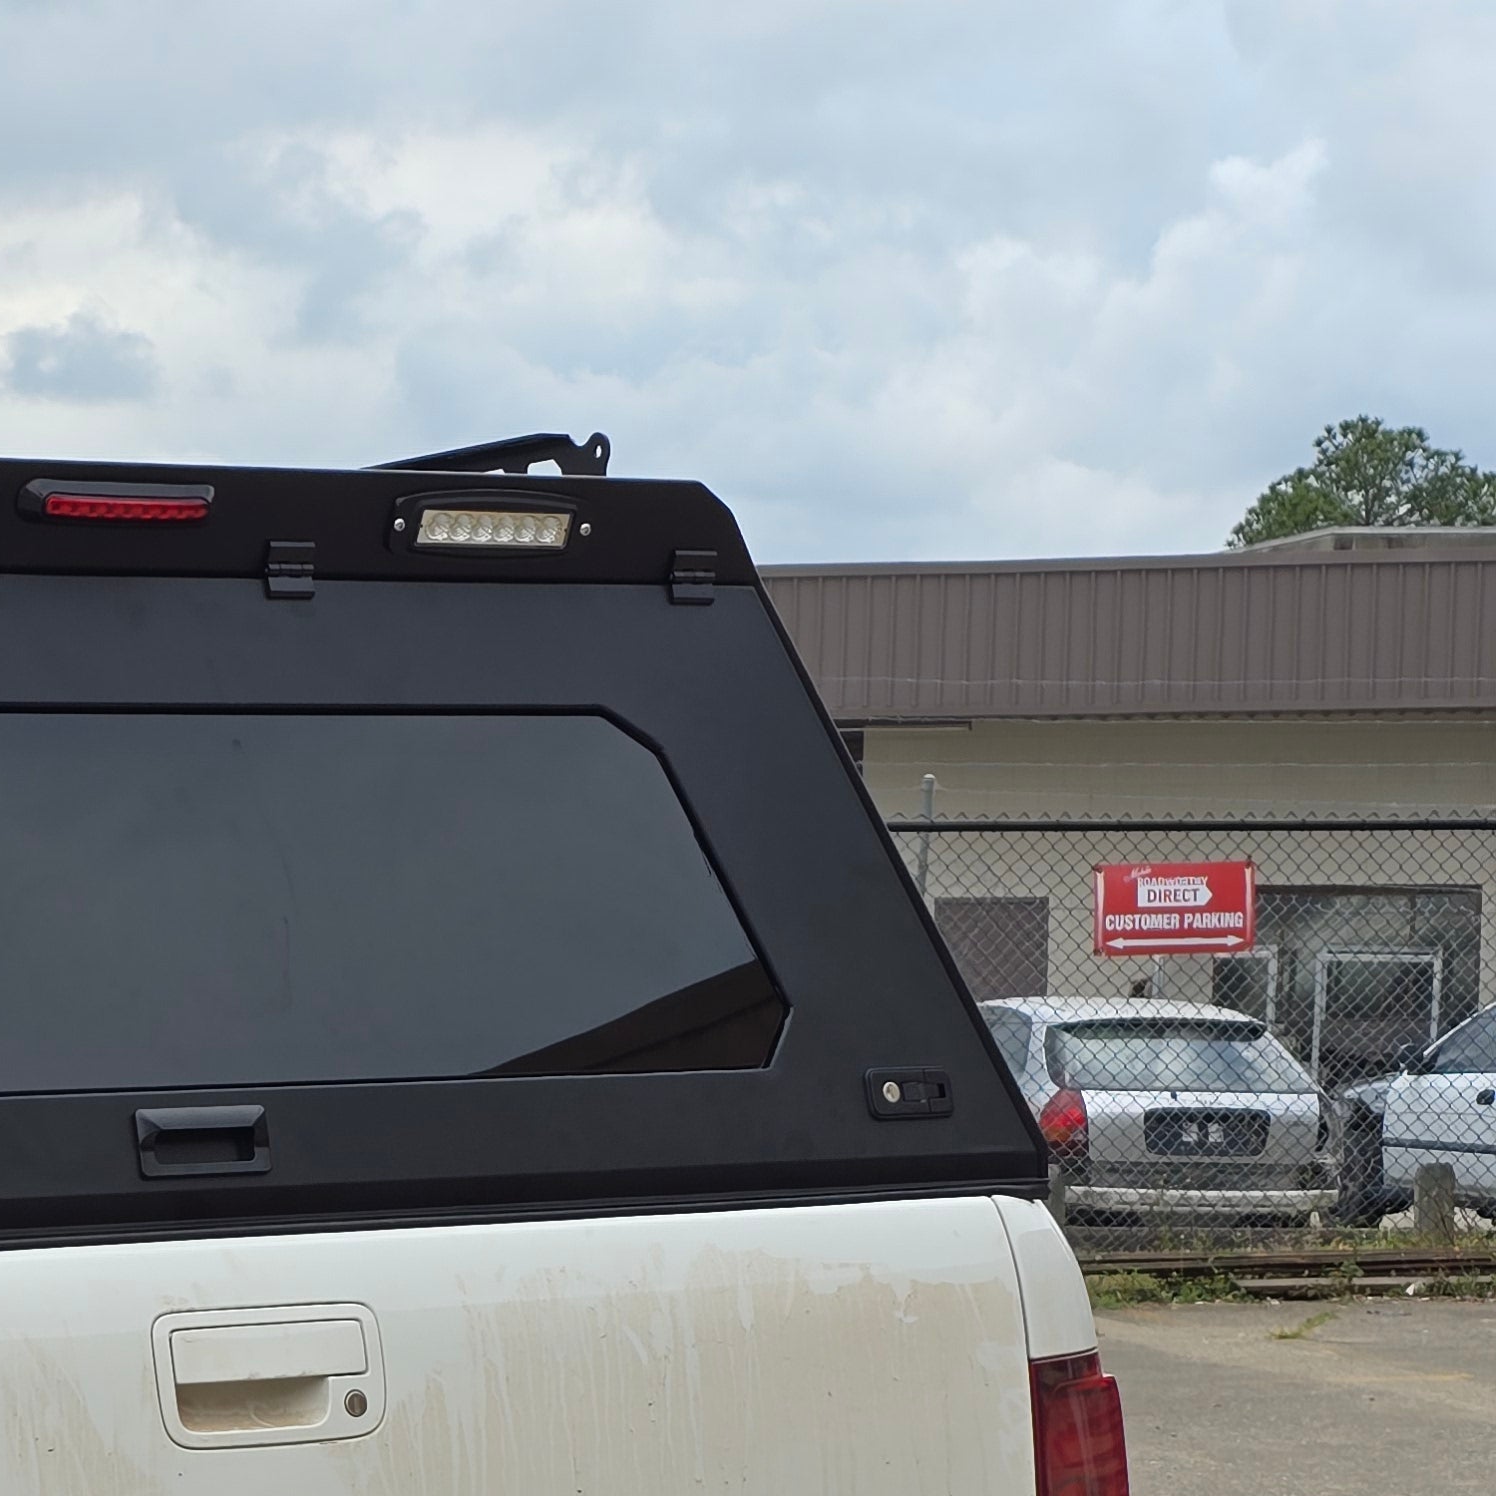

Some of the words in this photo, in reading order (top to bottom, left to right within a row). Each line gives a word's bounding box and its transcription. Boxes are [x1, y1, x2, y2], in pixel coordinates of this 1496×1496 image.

[1147, 888, 1200, 903] DIRECT
[1105, 913, 1180, 931] CUSTOMER
[1184, 911, 1244, 929] PARKING
